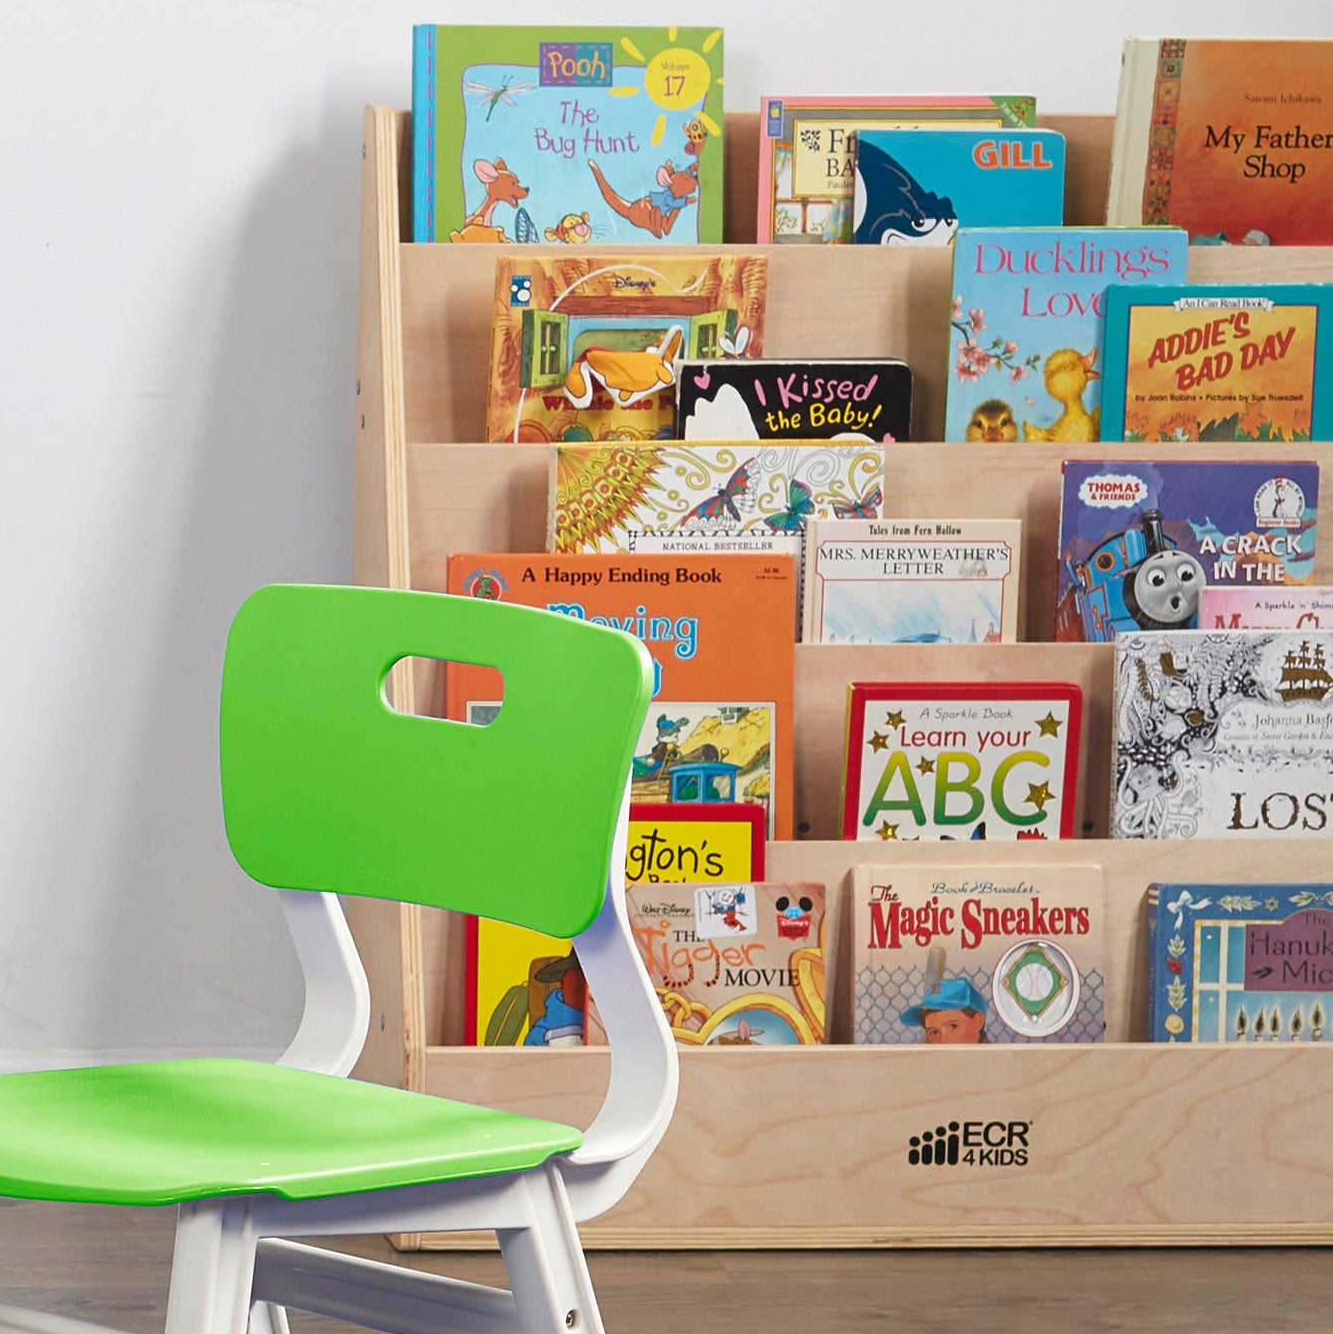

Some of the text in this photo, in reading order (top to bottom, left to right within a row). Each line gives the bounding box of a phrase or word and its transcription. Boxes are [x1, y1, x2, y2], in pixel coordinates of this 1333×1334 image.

[547, 50, 606, 79] Pooh
[664, 75, 686, 97] 17
[1280, 94, 1322, 104] Ichikawa
[560, 100, 600, 127] The
[535, 127, 641, 159] Bug Hunt
[1204, 125, 1247, 154] My
[972, 140, 1053, 170] GILL
[1243, 154, 1306, 184] Shop
[975, 238, 1171, 282] Ducklings
[612, 274, 657, 291] Disney's
[1201, 299, 1219, 308] Can
[1220, 299, 1240, 308] Read
[1147, 311, 1251, 368] ADDIE'S
[1176, 326, 1296, 391] BAD DAY
[754, 374, 879, 410] I Kissed
[765, 402, 883, 434] the Baby!
[1087, 482, 1141, 494] THOMAS
[1091, 493, 1136, 501] & FRIENDS
[869, 525, 962, 535] Tales from Fern Hollow
[663, 542, 773, 551] NATIONAL BESTSELLER
[819, 547, 1009, 561] MRS. MERRYWEATHER'S
[1199, 533, 1303, 556] A CRACK
[521, 568, 722, 586] A Happy Ending Book
[883, 562, 945, 575] LETTER
[1213, 561, 1285, 583] IN THE
[1264, 601, 1295, 611] Sparkle
[919, 708, 1013, 722] A Sparkle Book
[1253, 714, 1302, 729] Johanna
[900, 726, 1032, 752] Learn your
[862, 750, 1051, 827] ABC
[871, 884, 899, 902] The
[930, 881, 970, 894] Book
[977, 880, 1036, 894] Bracelet
[660, 902, 691, 916] Disney
[868, 896, 1091, 950] Magic Sneakers
[1303, 914, 1331, 926] The
[633, 920, 767, 988] Tigger
[724, 969, 801, 987] MOVIE
[963, 1121, 1030, 1147] ECR
[962, 1149, 1029, 1166] 4 KIDS
